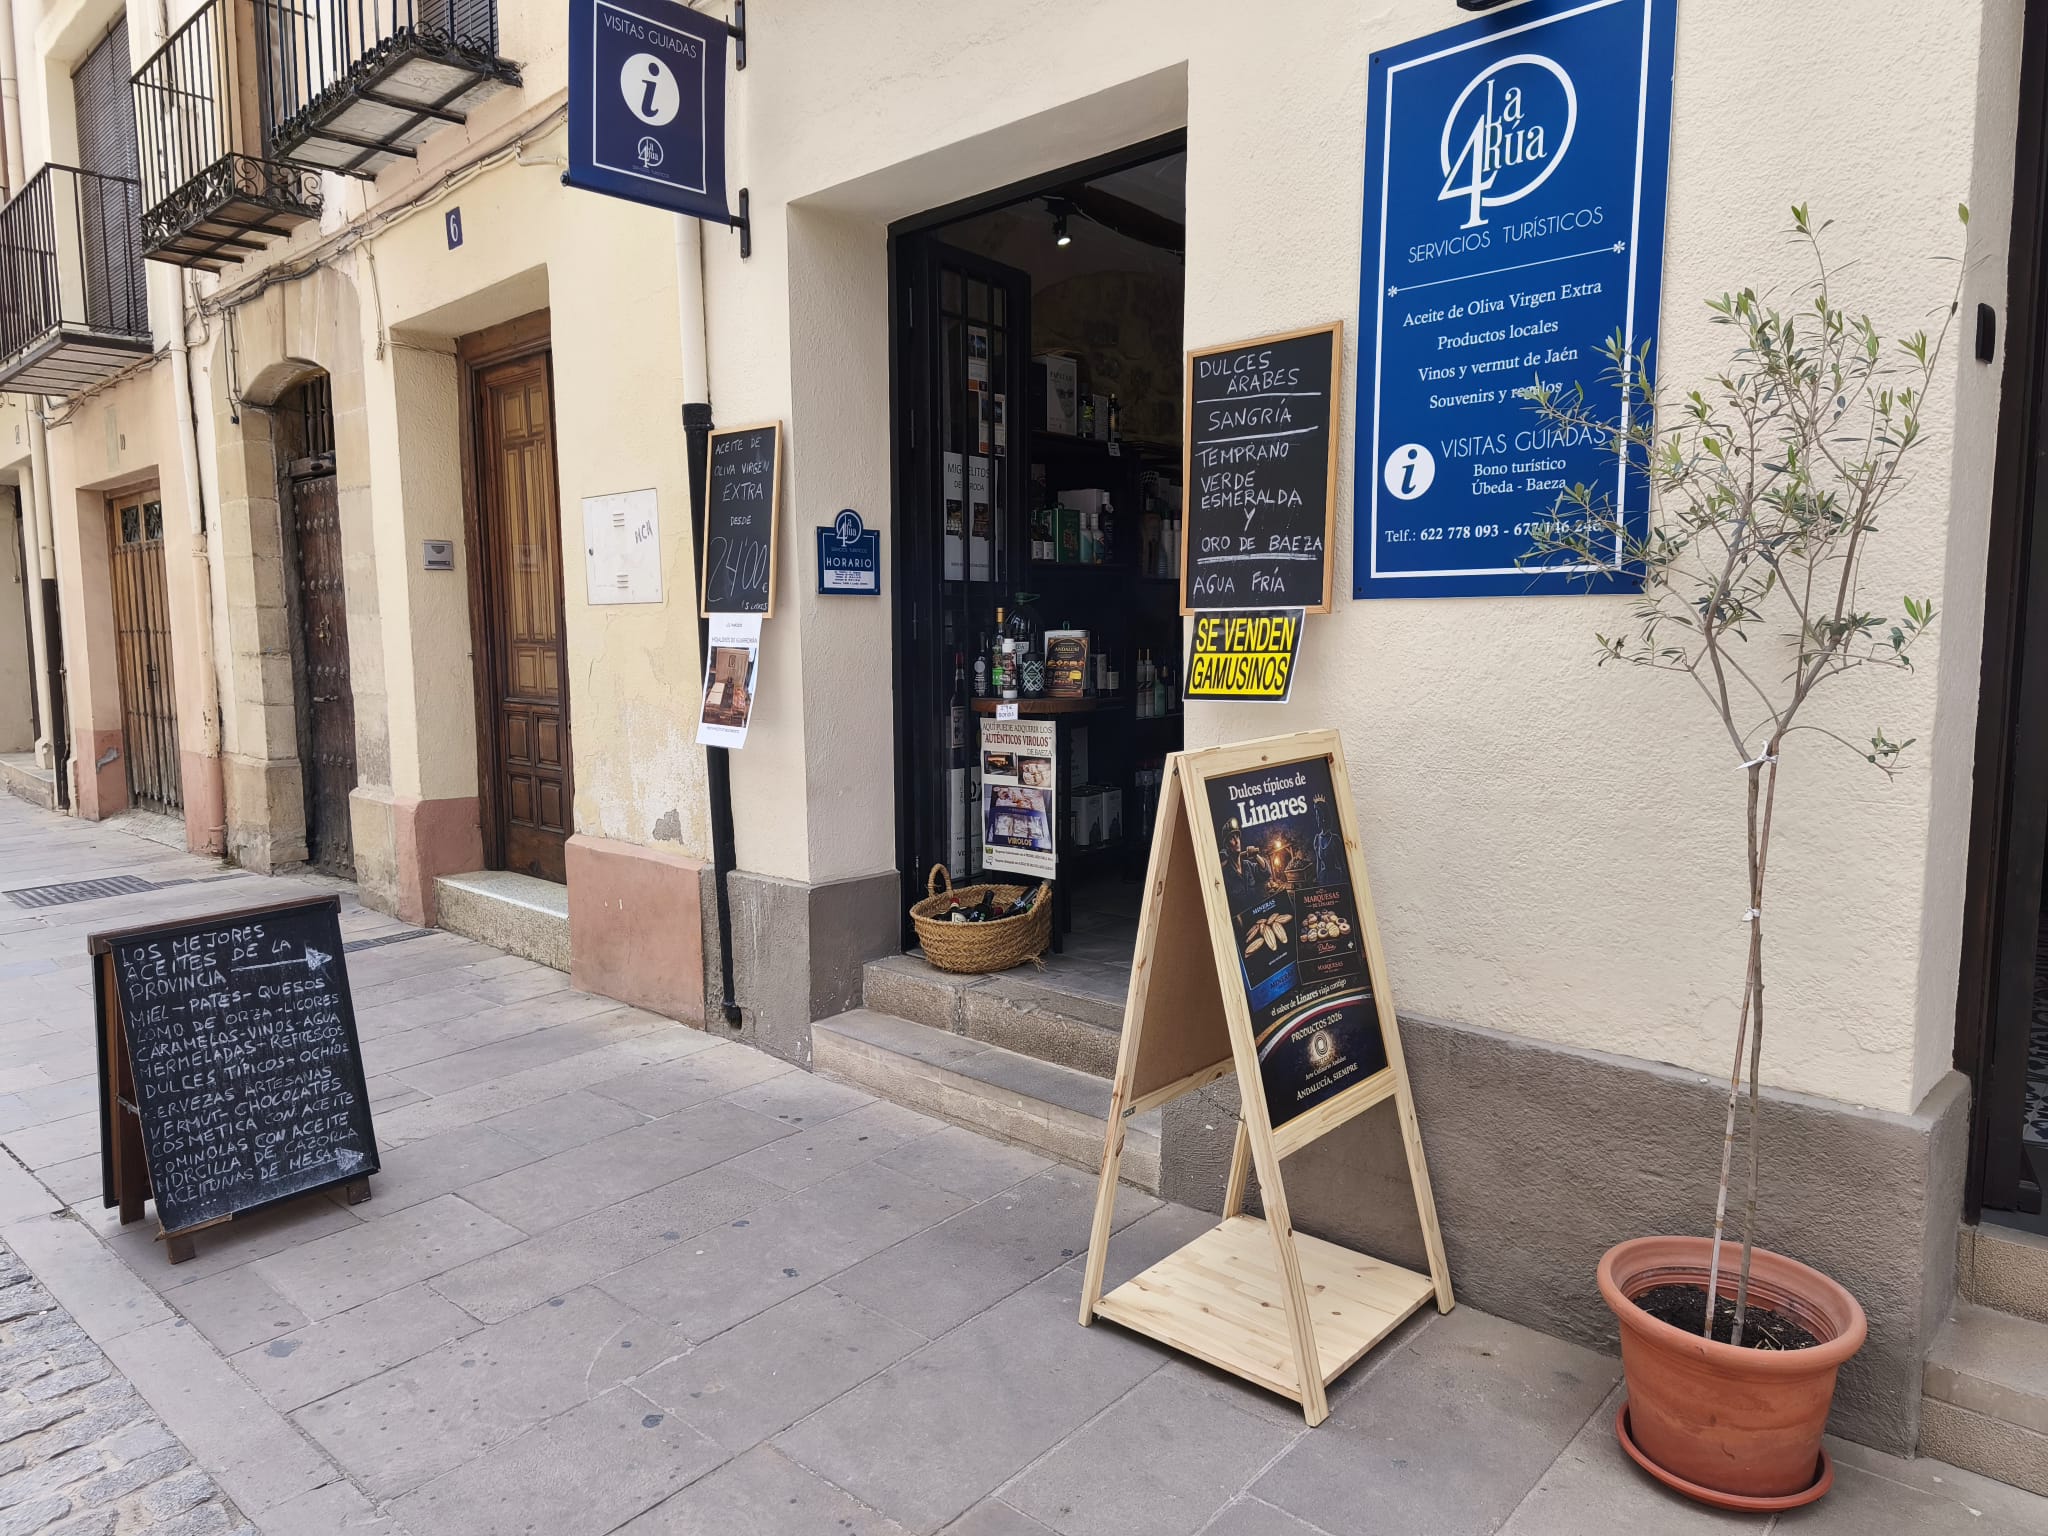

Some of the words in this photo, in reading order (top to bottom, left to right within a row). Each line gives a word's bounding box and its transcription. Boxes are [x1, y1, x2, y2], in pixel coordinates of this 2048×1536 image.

[604, 13, 645, 40] VISITAS
[648, 30, 697, 58] GUIADAS
[1484, 79, 1526, 129] La
[1482, 119, 1548, 173] Rúa
[449, 214, 459, 242] 6
[1407, 230, 1492, 264] SERVICIOS
[1503, 205, 1604, 244] TURÍSTICOS
[1402, 306, 1445, 327] Aceite
[1447, 303, 1464, 321] de
[1467, 299, 1505, 317] Oliva
[1509, 289, 1557, 309] Virgen
[1560, 281, 1603, 300] Extra
[1437, 327, 1506, 350] Productos
[1509, 320, 1559, 339] locales
[1200, 351, 1272, 378] DULCES
[1418, 366, 1456, 382] Vinos
[1458, 364, 1468, 378] y
[1471, 357, 1521, 374] vermut
[1523, 352, 1541, 367] de
[1544, 346, 1579, 364] Jaén
[1429, 387, 1495, 409] Souvenirs
[1498, 389, 1508, 403] y
[1208, 397, 1292, 432] SANGRÍA
[715, 439, 744, 455] ACEITE
[751, 437, 762, 448] DE
[1195, 442, 1289, 468] TEMPRANO
[1441, 434, 1507, 459] VISITAS
[1514, 426, 1606, 451] GUIADAS
[714, 464, 736, 477] OLIVA
[742, 461, 770, 474] VIRGEN
[947, 463, 990, 478] MIGELITOS
[1473, 464, 1508, 477] Bono
[1511, 458, 1566, 473] turístico
[722, 481, 764, 502] EXTRA
[1200, 472, 1255, 494] VERDE
[1472, 480, 1514, 495] Úbeda
[1525, 478, 1566, 491] Baeza
[1201, 488, 1303, 510] ESMERALDA
[730, 515, 752, 526] DESDE
[1244, 507, 1256, 532] Y
[1384, 530, 1416, 543] Telf.:
[1420, 527, 1443, 541] 622
[1448, 526, 1471, 540] 778
[1475, 524, 1499, 538] 093
[1201, 536, 1231, 552] ORO
[1239, 537, 1256, 552] DE
[1269, 534, 1323, 551] BAEZA
[826, 557, 872, 568] HORARIO
[1193, 574, 1235, 596] AGUA
[1251, 566, 1285, 593] FRÍA
[1196, 618, 1220, 652] SE
[1224, 617, 1296, 651] VENDEN
[1192, 656, 1290, 691] GAMUSINOS
[983, 722, 995, 731] AQUÍ
[995, 723, 1014, 731] PUEDE
[1039, 726, 1053, 734] LOS
[1034, 749, 1053, 757] BAEZA
[1228, 782, 1262, 801] Dulces
[1263, 776, 1294, 796] típicos
[1295, 771, 1307, 786] de
[1237, 795, 1308, 828] Linares
[1008, 836, 1032, 847] VIROLOS
[1303, 891, 1340, 904] MARQUESAS
[121, 944, 162, 967] LOS
[172, 924, 265, 955] MEJORES
[125, 952, 217, 983] ACEITES
[232, 943, 258, 961] DE
[271, 939, 292, 954] LA
[129, 969, 227, 1004] PROVINCIA
[1290, 1000, 1296, 1008] de
[1296, 990, 1319, 1006] Linares
[1319, 985, 1330, 996] viaja
[1330, 978, 1347, 991] contigo
[129, 1005, 169, 1029] MIEL
[258, 978, 326, 999] QUESOS
[137, 1023, 184, 1043] LOMO
[192, 1016, 217, 1032] DE
[225, 1008, 272, 1025] ORZA
[284, 993, 339, 1013] LICORES
[1291, 1018, 1328, 1043] PRODUCTOS
[145, 1069, 216, 1099] DULCES
[223, 1056, 285, 1080] TÍPICOS
[245, 1066, 332, 1096] ARTESANAS
[1296, 1075, 1333, 1101] ANDALUCÍA,
[1332, 1062, 1359, 1081] SIEMPRE
[234, 1077, 342, 1116] CHOCOLATES
[152, 1118, 258, 1158] COSMETICA
[265, 1107, 295, 1124] CON
[301, 1091, 355, 1118] ACEITE
[254, 1129, 286, 1148] CON
[292, 1112, 349, 1139] ACEITE
[157, 1156, 242, 1193] MORCILLA
[254, 1145, 275, 1166] DE
[284, 1127, 359, 1153] CAZORLA
[165, 1168, 254, 1208] ACEITUNAS
[260, 1160, 281, 1180] DE
